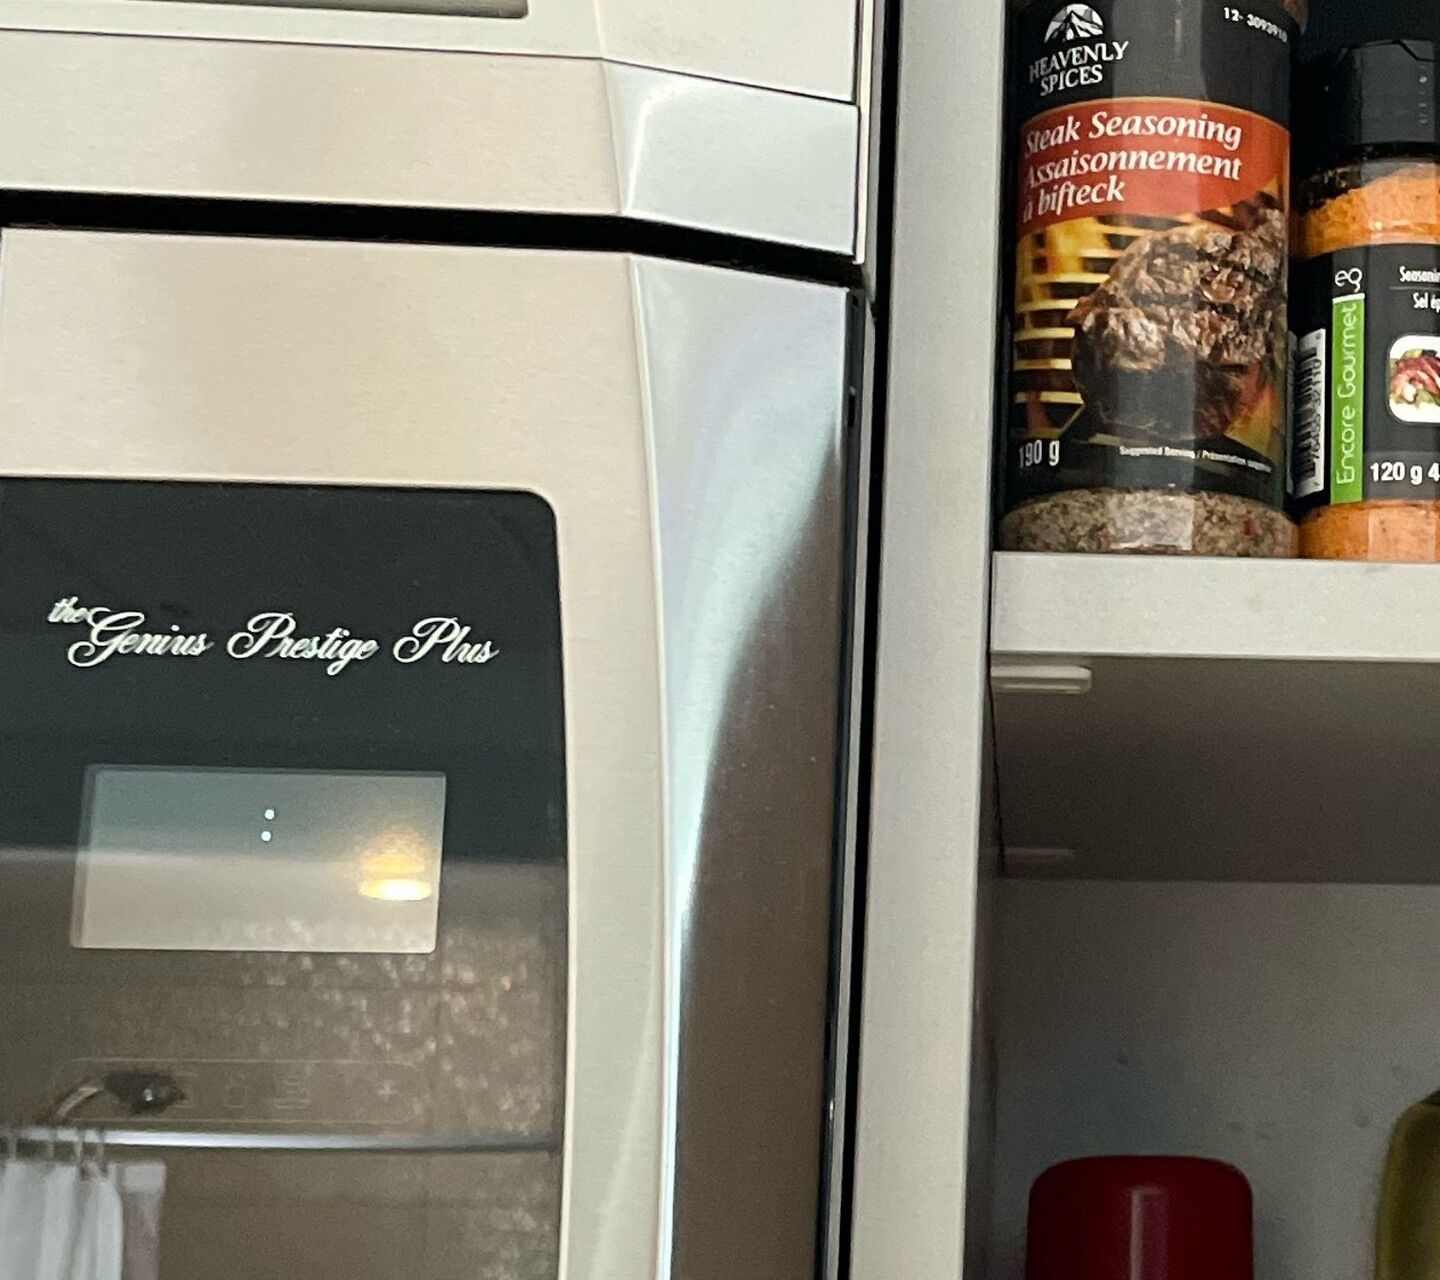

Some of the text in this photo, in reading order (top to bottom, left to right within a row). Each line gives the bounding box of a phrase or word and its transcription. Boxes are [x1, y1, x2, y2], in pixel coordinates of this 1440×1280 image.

[1029, 41, 1130, 83] HEAVENLY
[1040, 64, 1103, 97] SPICES
[1025, 111, 1242, 158] Steak Seasoning
[1025, 149, 1242, 189] Assaisonnement
[1037, 175, 1126, 216] bifteck
[1413, 292, 1428, 309] Sel
[1336, 303, 1357, 485] Encore Gourmet
[1019, 440, 1060, 469] 190 g
[1370, 461, 1405, 482] 120
[1410, 465, 1423, 484] g
[47, 596, 500, 676] the Genius Prestige Plus
